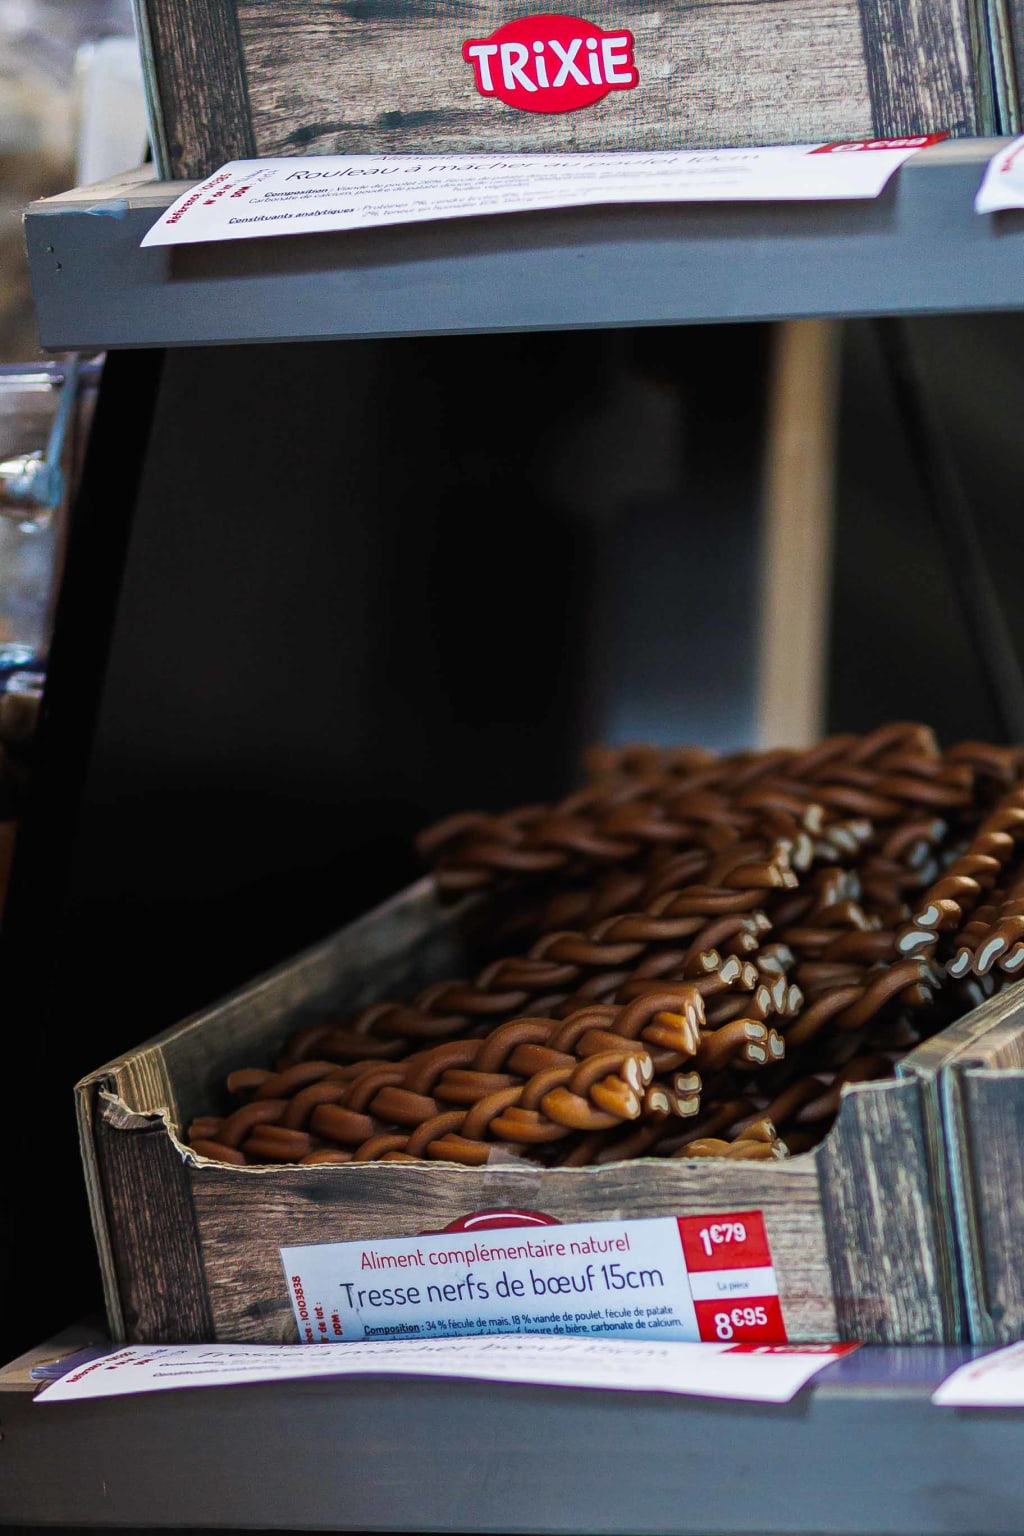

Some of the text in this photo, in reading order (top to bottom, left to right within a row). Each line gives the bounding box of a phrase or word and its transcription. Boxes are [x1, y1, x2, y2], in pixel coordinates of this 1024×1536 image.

[285, 167, 399, 181] Rouleau
[404, 165, 422, 174] à
[429, 161, 534, 172] mâcher
[264, 188, 329, 198] Composition
[228, 207, 356, 224] Constituants analytiques
[361, 1232, 631, 1270] Aliment complémentaire naturel
[699, 1222, 747, 1256] 1€79
[340, 1262, 665, 1309] Tresse nerfs de bœuf 15cm
[331, 1314, 344, 1336] DDM
[364, 1322, 420, 1337] Composition
[425, 1320, 436, 1331] 34
[448, 1317, 475, 1329] fécule
[476, 1317, 487, 1327] de
[512, 1315, 521, 1325] 18
[532, 1312, 561, 1324] viande
[562, 1311, 574, 1322] de
[605, 1308, 632, 1319] fécule
[634, 1307, 645, 1317] de
[646, 1305, 673, 1317] patate
[553, 1323, 565, 1335] de
[591, 1319, 634, 1332] carbonate
[636, 1318, 647, 1329] de
[714, 1306, 768, 1340] 8€95
